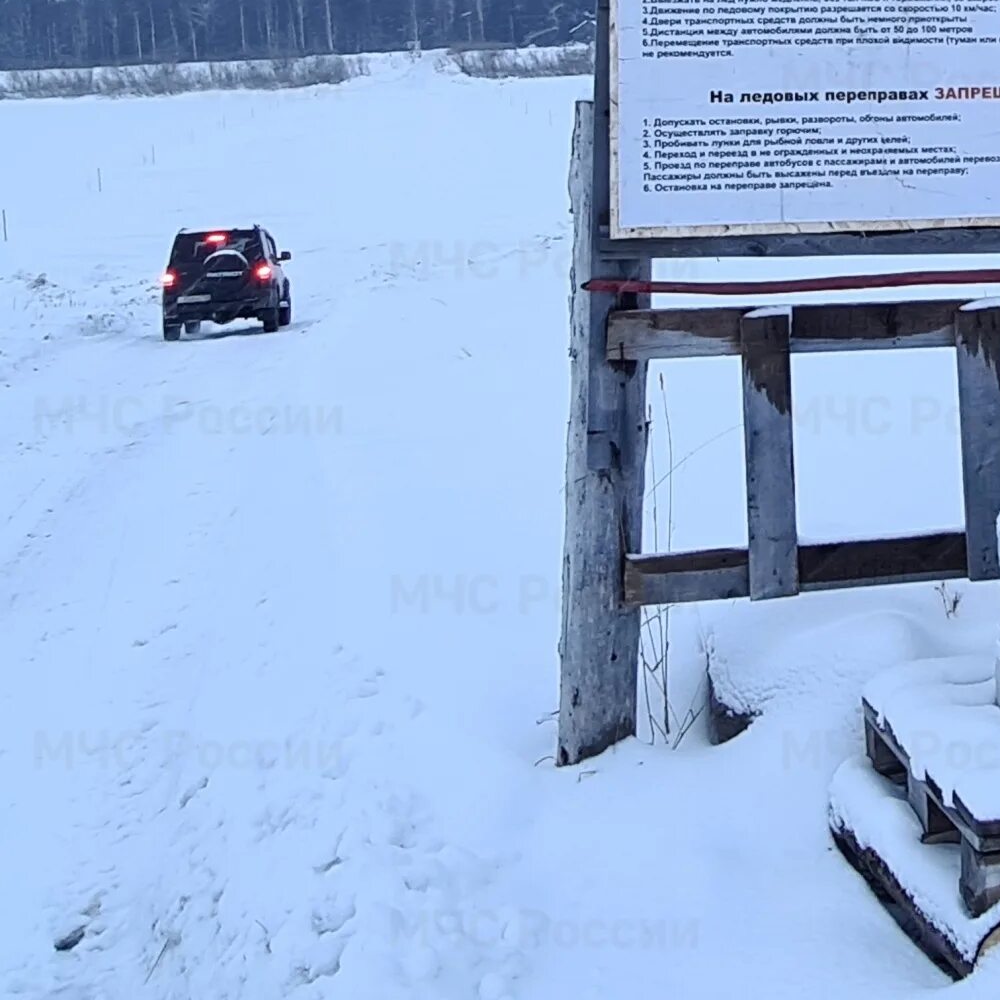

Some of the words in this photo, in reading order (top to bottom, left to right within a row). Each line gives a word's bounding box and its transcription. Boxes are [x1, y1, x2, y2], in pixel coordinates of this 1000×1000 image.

[642, 6, 700, 15] 3.Движение
[716, 7, 766, 15] ледовому
[767, 6, 819, 15] покрытию
[820, 6, 882, 14] разрешается
[897, 5, 949, 14] скоростью
[950, 4, 962, 12] 10
[963, 4, 998, 14] км/час;
[641, 17, 682, 26] 4.Двери
[684, 18, 755, 26] транспортных
[756, 17, 797, 26] средств
[797, 17, 838, 25] должны
[839, 15, 866, 24] быть
[642, 27, 704, 37] 5.Дистанция
[706, 28, 738, 37] между
[740, 27, 813, 35] автомобилями
[814, 27, 852, 36] должна
[853, 25, 879, 35] быть
[893, 25, 905, 34] 50
[905, 26, 919, 35] до
[920, 25, 937, 34] 100
[938, 27, 973, 35] метров
[642, 38, 720, 48] 6.Перемещение
[721, 39, 792, 47] транспортных
[794, 38, 834, 47] средств
[835, 38, 854, 47] при
[855, 37, 890, 45] плохой
[892, 37, 944, 46] видимости
[945, 36, 977, 46] (туман
[656, 50, 735, 59] рекомендуется.
[710, 90, 734, 103] На
[739, 91, 819, 105] ледовых
[825, 90, 929, 104] переправах
[652, 117, 706, 127] Допускать
[708, 118, 764, 126] остановки,
[764, 117, 800, 126] рывки,
[801, 116, 858, 125] развороты,
[895, 114, 962, 124] автомобилей;
[653, 128, 727, 138] Осуществлять
[728, 128, 774, 137] заправку
[775, 128, 823, 136] горючим;
[653, 139, 709, 149] Пробивать
[710, 139, 741, 148] лунки
[742, 139, 762, 148] для
[763, 137, 802, 147] рыбной
[844, 137, 878, 146] других
[654, 150, 698, 160] Переход
[707, 150, 749, 159] переезд
[773, 149, 839, 157] огражденных
[920, 147, 958, 155] местах;
[654, 161, 692, 170] Проезд
[708, 160, 761, 169] переправе
[763, 158, 814, 168] автобусов
[897, 155, 961, 164] автомобилей
[642, 172, 702, 181] Пассажиры
[702, 172, 744, 180] должны
[745, 170, 772, 178] быть
[774, 170, 826, 178] высажены
[828, 170, 858, 178] перед
[915, 168, 970, 177] переправу;
[654, 182, 708, 191] Остановка
[724, 182, 777, 191] переправе
